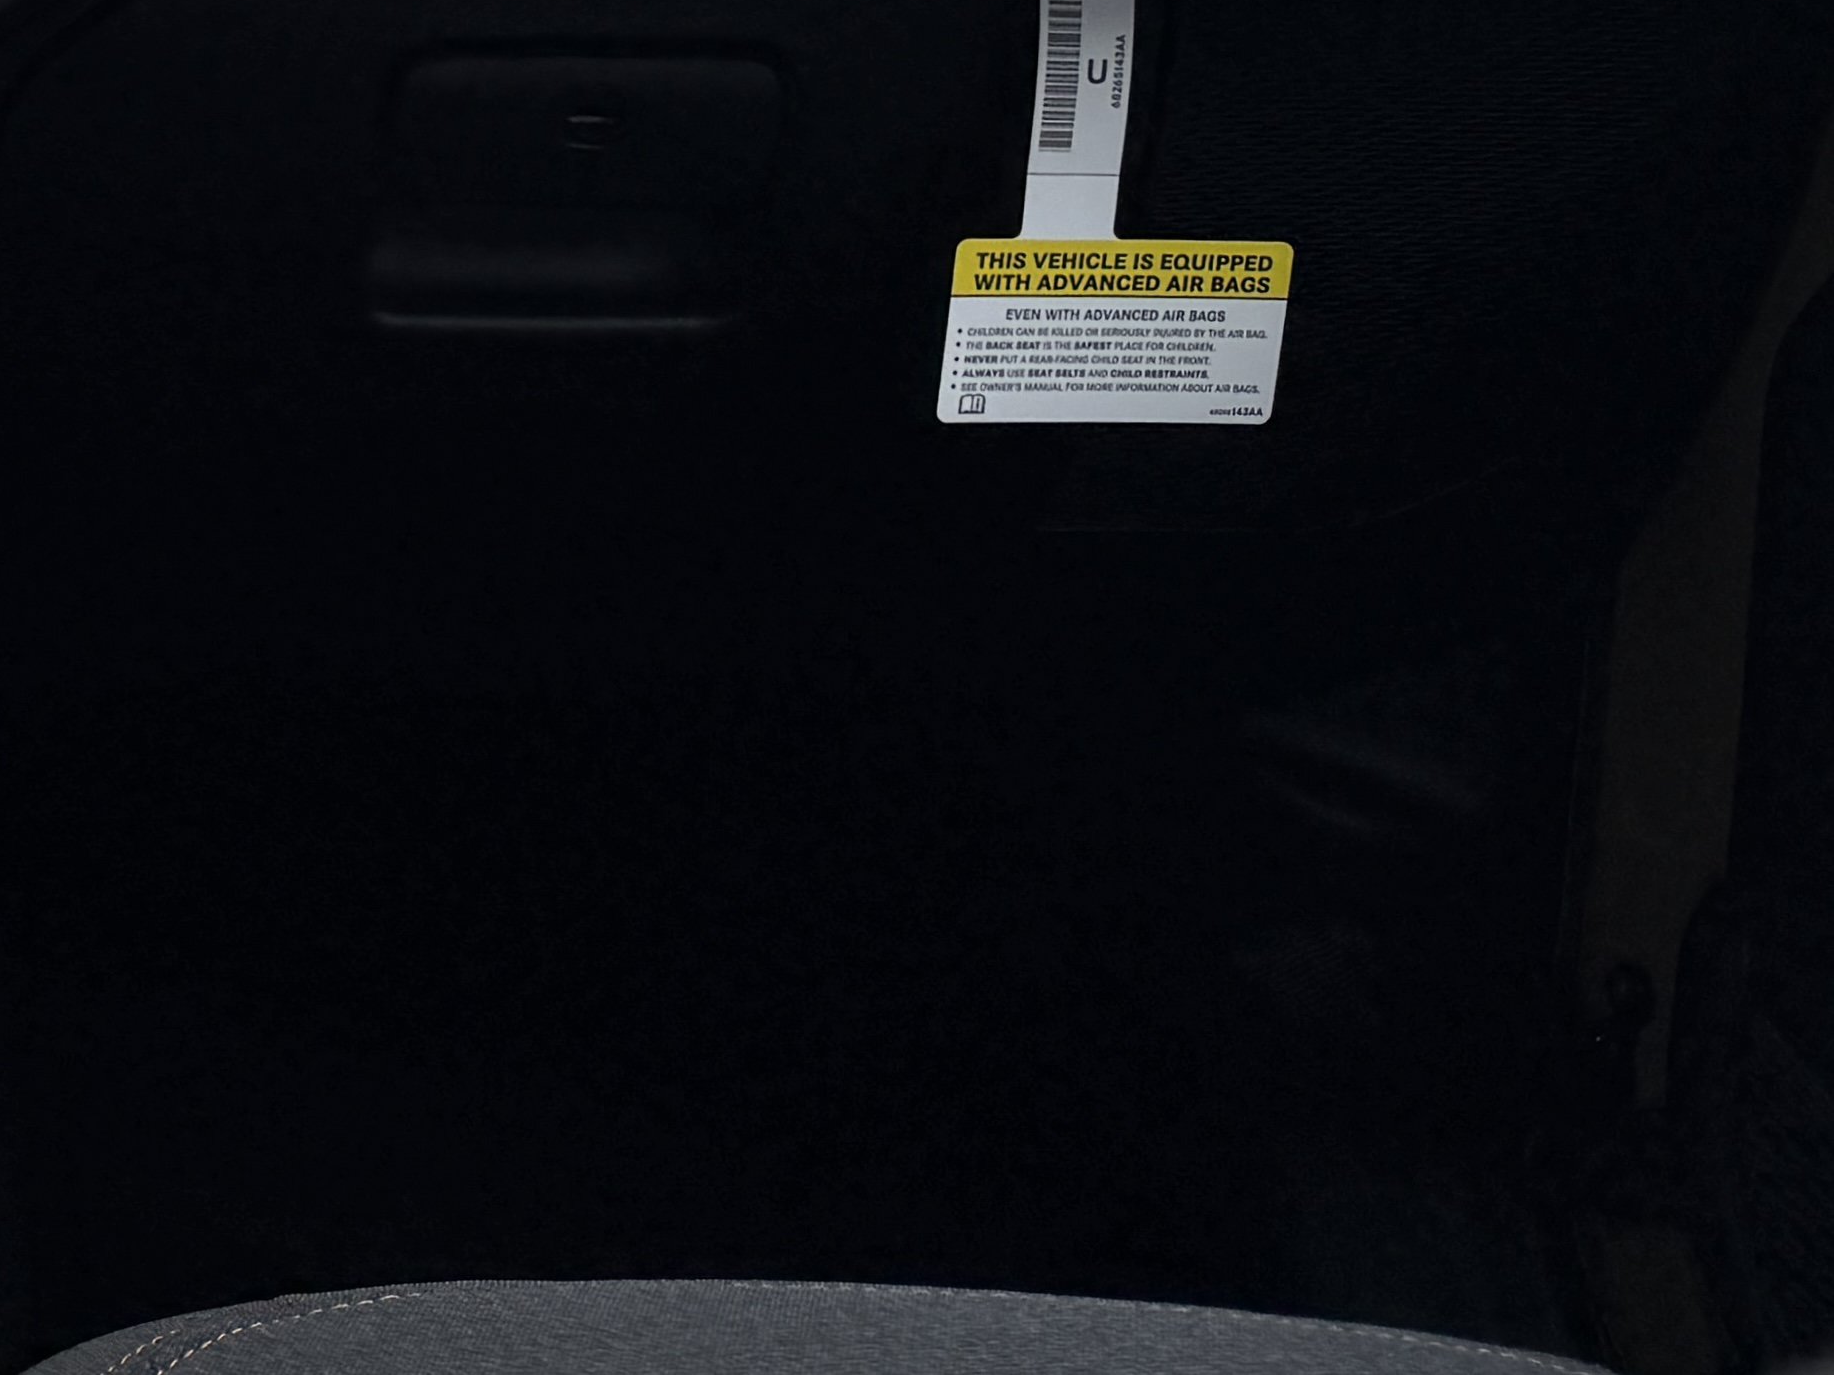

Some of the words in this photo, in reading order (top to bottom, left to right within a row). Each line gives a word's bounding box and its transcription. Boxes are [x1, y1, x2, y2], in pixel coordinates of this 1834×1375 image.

[976, 252, 1027, 269] THIS
[1033, 252, 1128, 270] VEHICLE
[1133, 253, 1154, 270] IS
[1160, 254, 1273, 272] EQUIPPED
[974, 274, 1031, 291] WITH
[1036, 274, 1161, 292] ADVANCED
[1166, 276, 1203, 292] AIR
[1210, 276, 1271, 293] BAGS
[1005, 309, 1041, 321] EVEN
[1045, 309, 1080, 321] WITH
[1084, 309, 1159, 322] ADVANCED
[1162, 310, 1185, 322] AIR
[1189, 310, 1226, 322] BAGS
[985, 341, 1014, 351] BACK
[1074, 342, 1112, 351] SAFEST
[961, 368, 1005, 378] ALWAYS
[1027, 369, 1053, 378] SEAT
[1055, 369, 1085, 379] BELTS
[1110, 370, 1142, 379] CHILD
